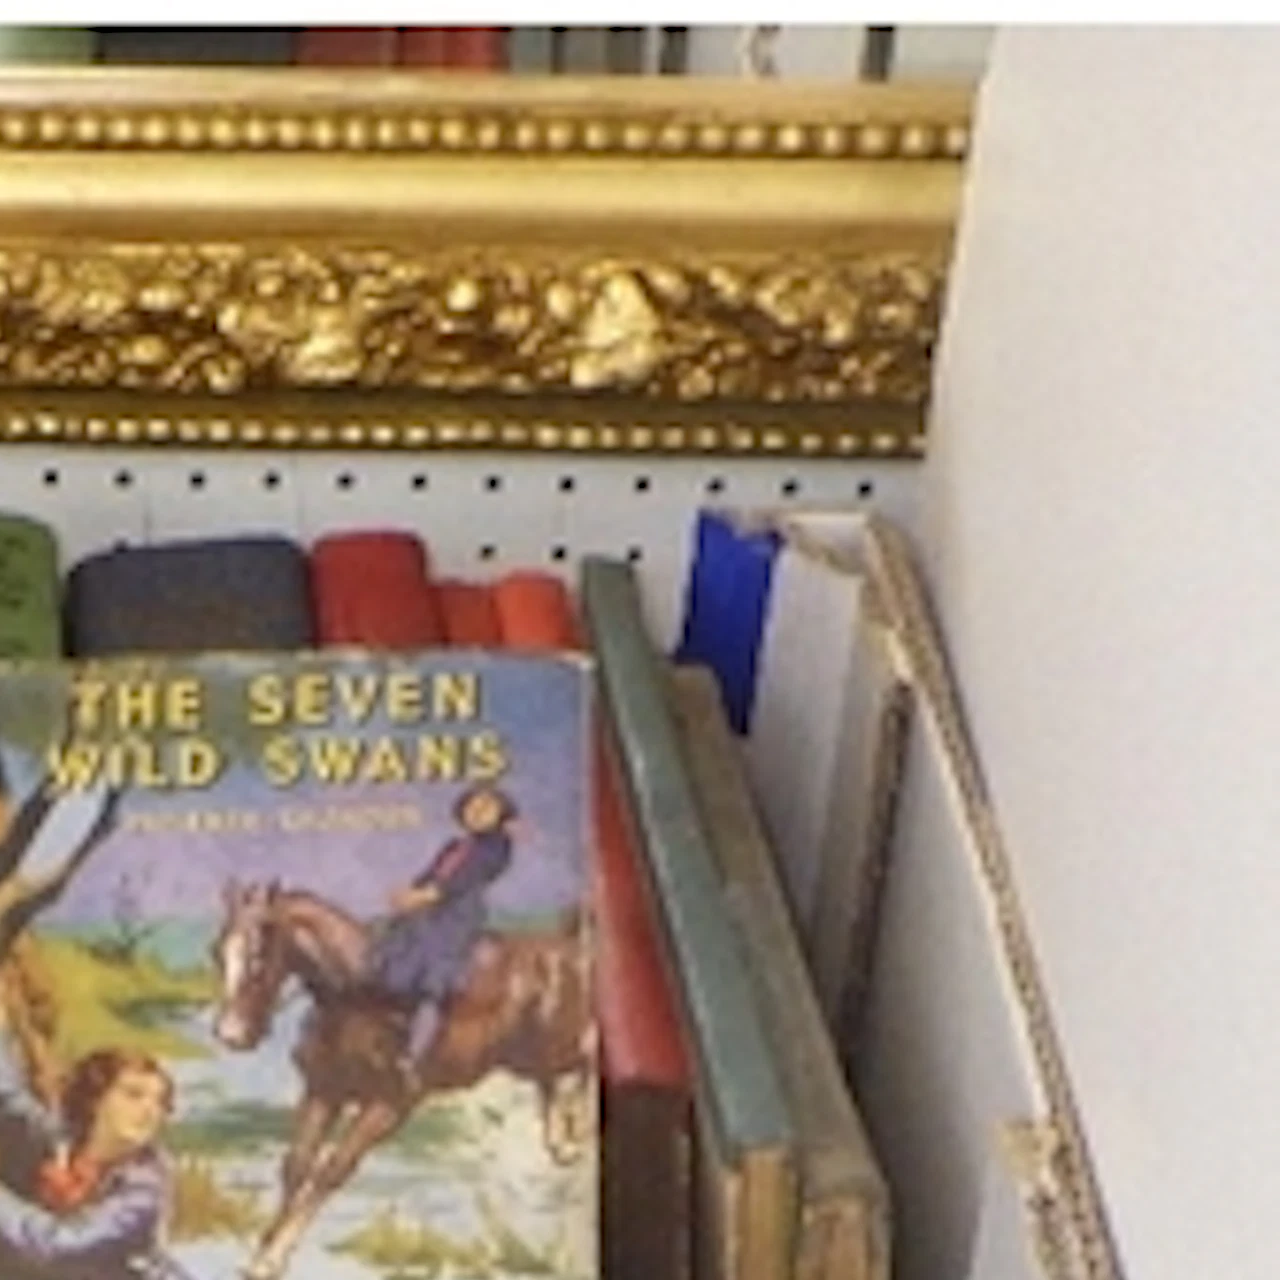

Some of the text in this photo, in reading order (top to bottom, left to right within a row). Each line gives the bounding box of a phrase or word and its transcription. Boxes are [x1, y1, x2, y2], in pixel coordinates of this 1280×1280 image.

[73, 671, 482, 731] THE SEVEN
[45, 730, 508, 791] WILD SWANS
